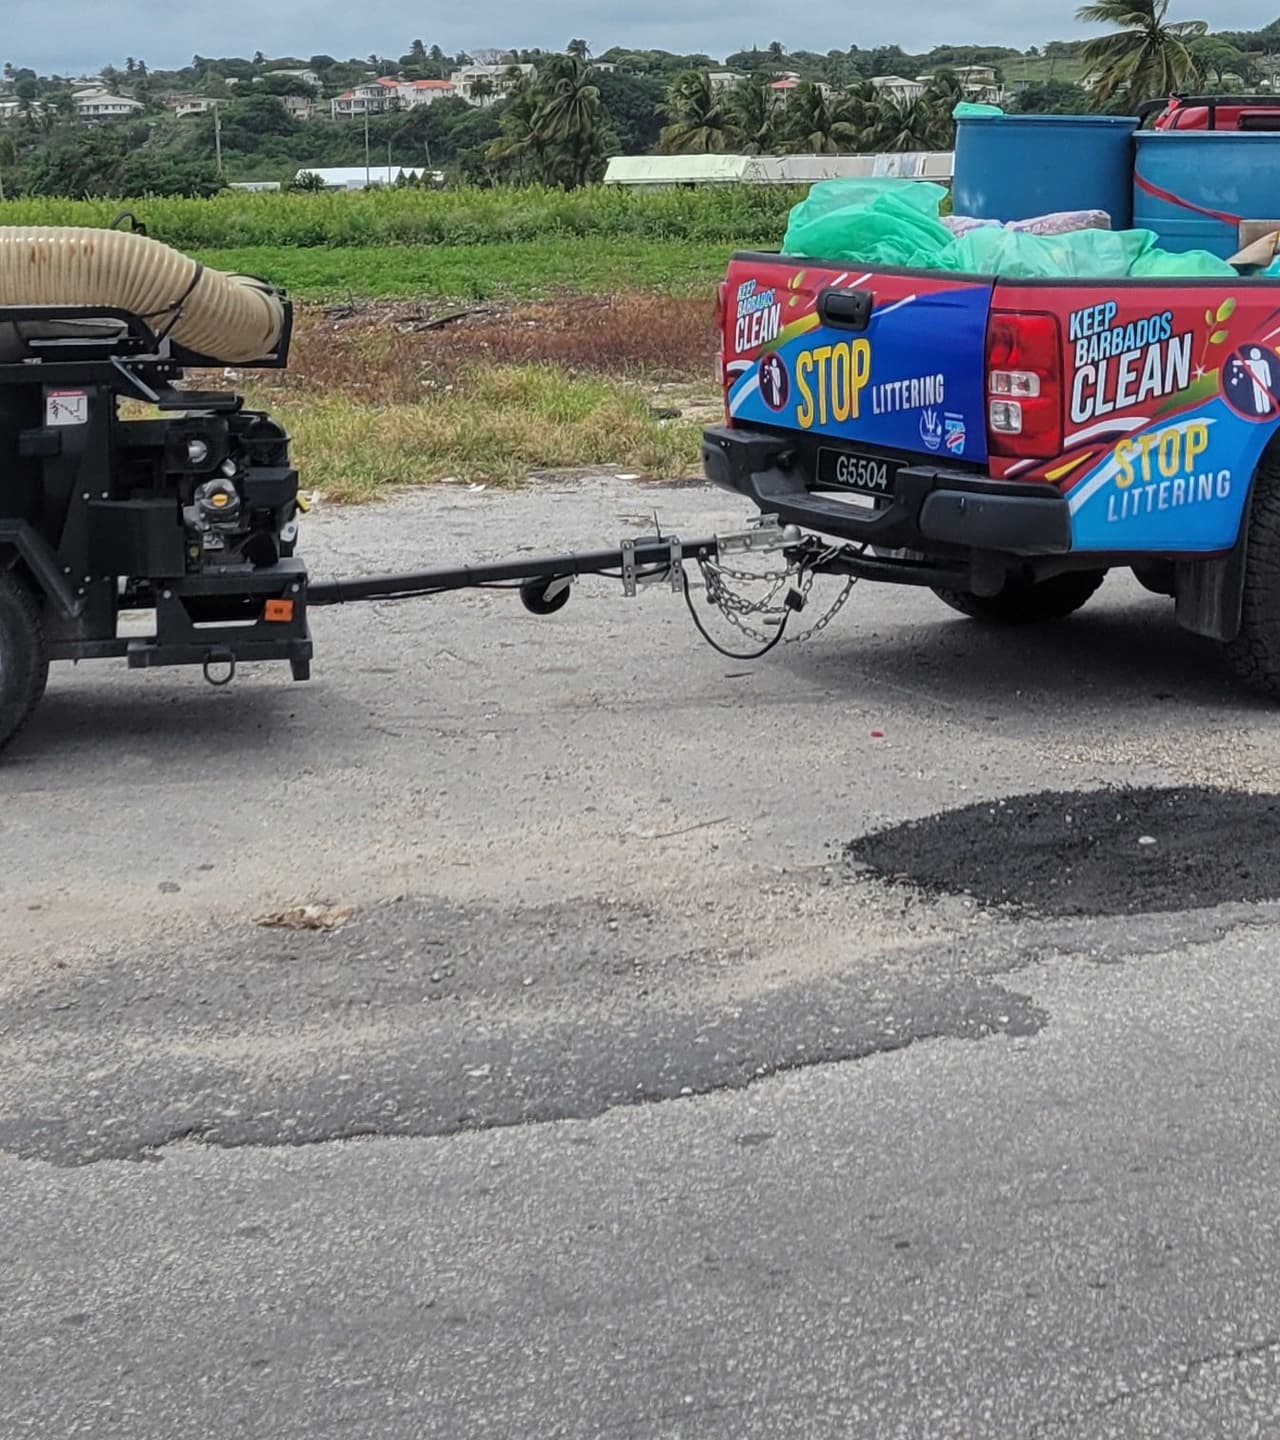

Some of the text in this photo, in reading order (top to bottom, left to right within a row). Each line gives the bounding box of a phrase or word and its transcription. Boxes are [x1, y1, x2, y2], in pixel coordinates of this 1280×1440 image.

[735, 302, 781, 354] CLEAN
[1069, 301, 1117, 341] KEEP
[1075, 311, 1172, 368] BARBADOS
[796, 338, 944, 429] STOP LITTERING
[1070, 333, 1193, 424] CLEAN
[836, 456, 888, 490] G5504
[1114, 424, 1209, 490] STOP
[1107, 469, 1231, 522] LITTERING
